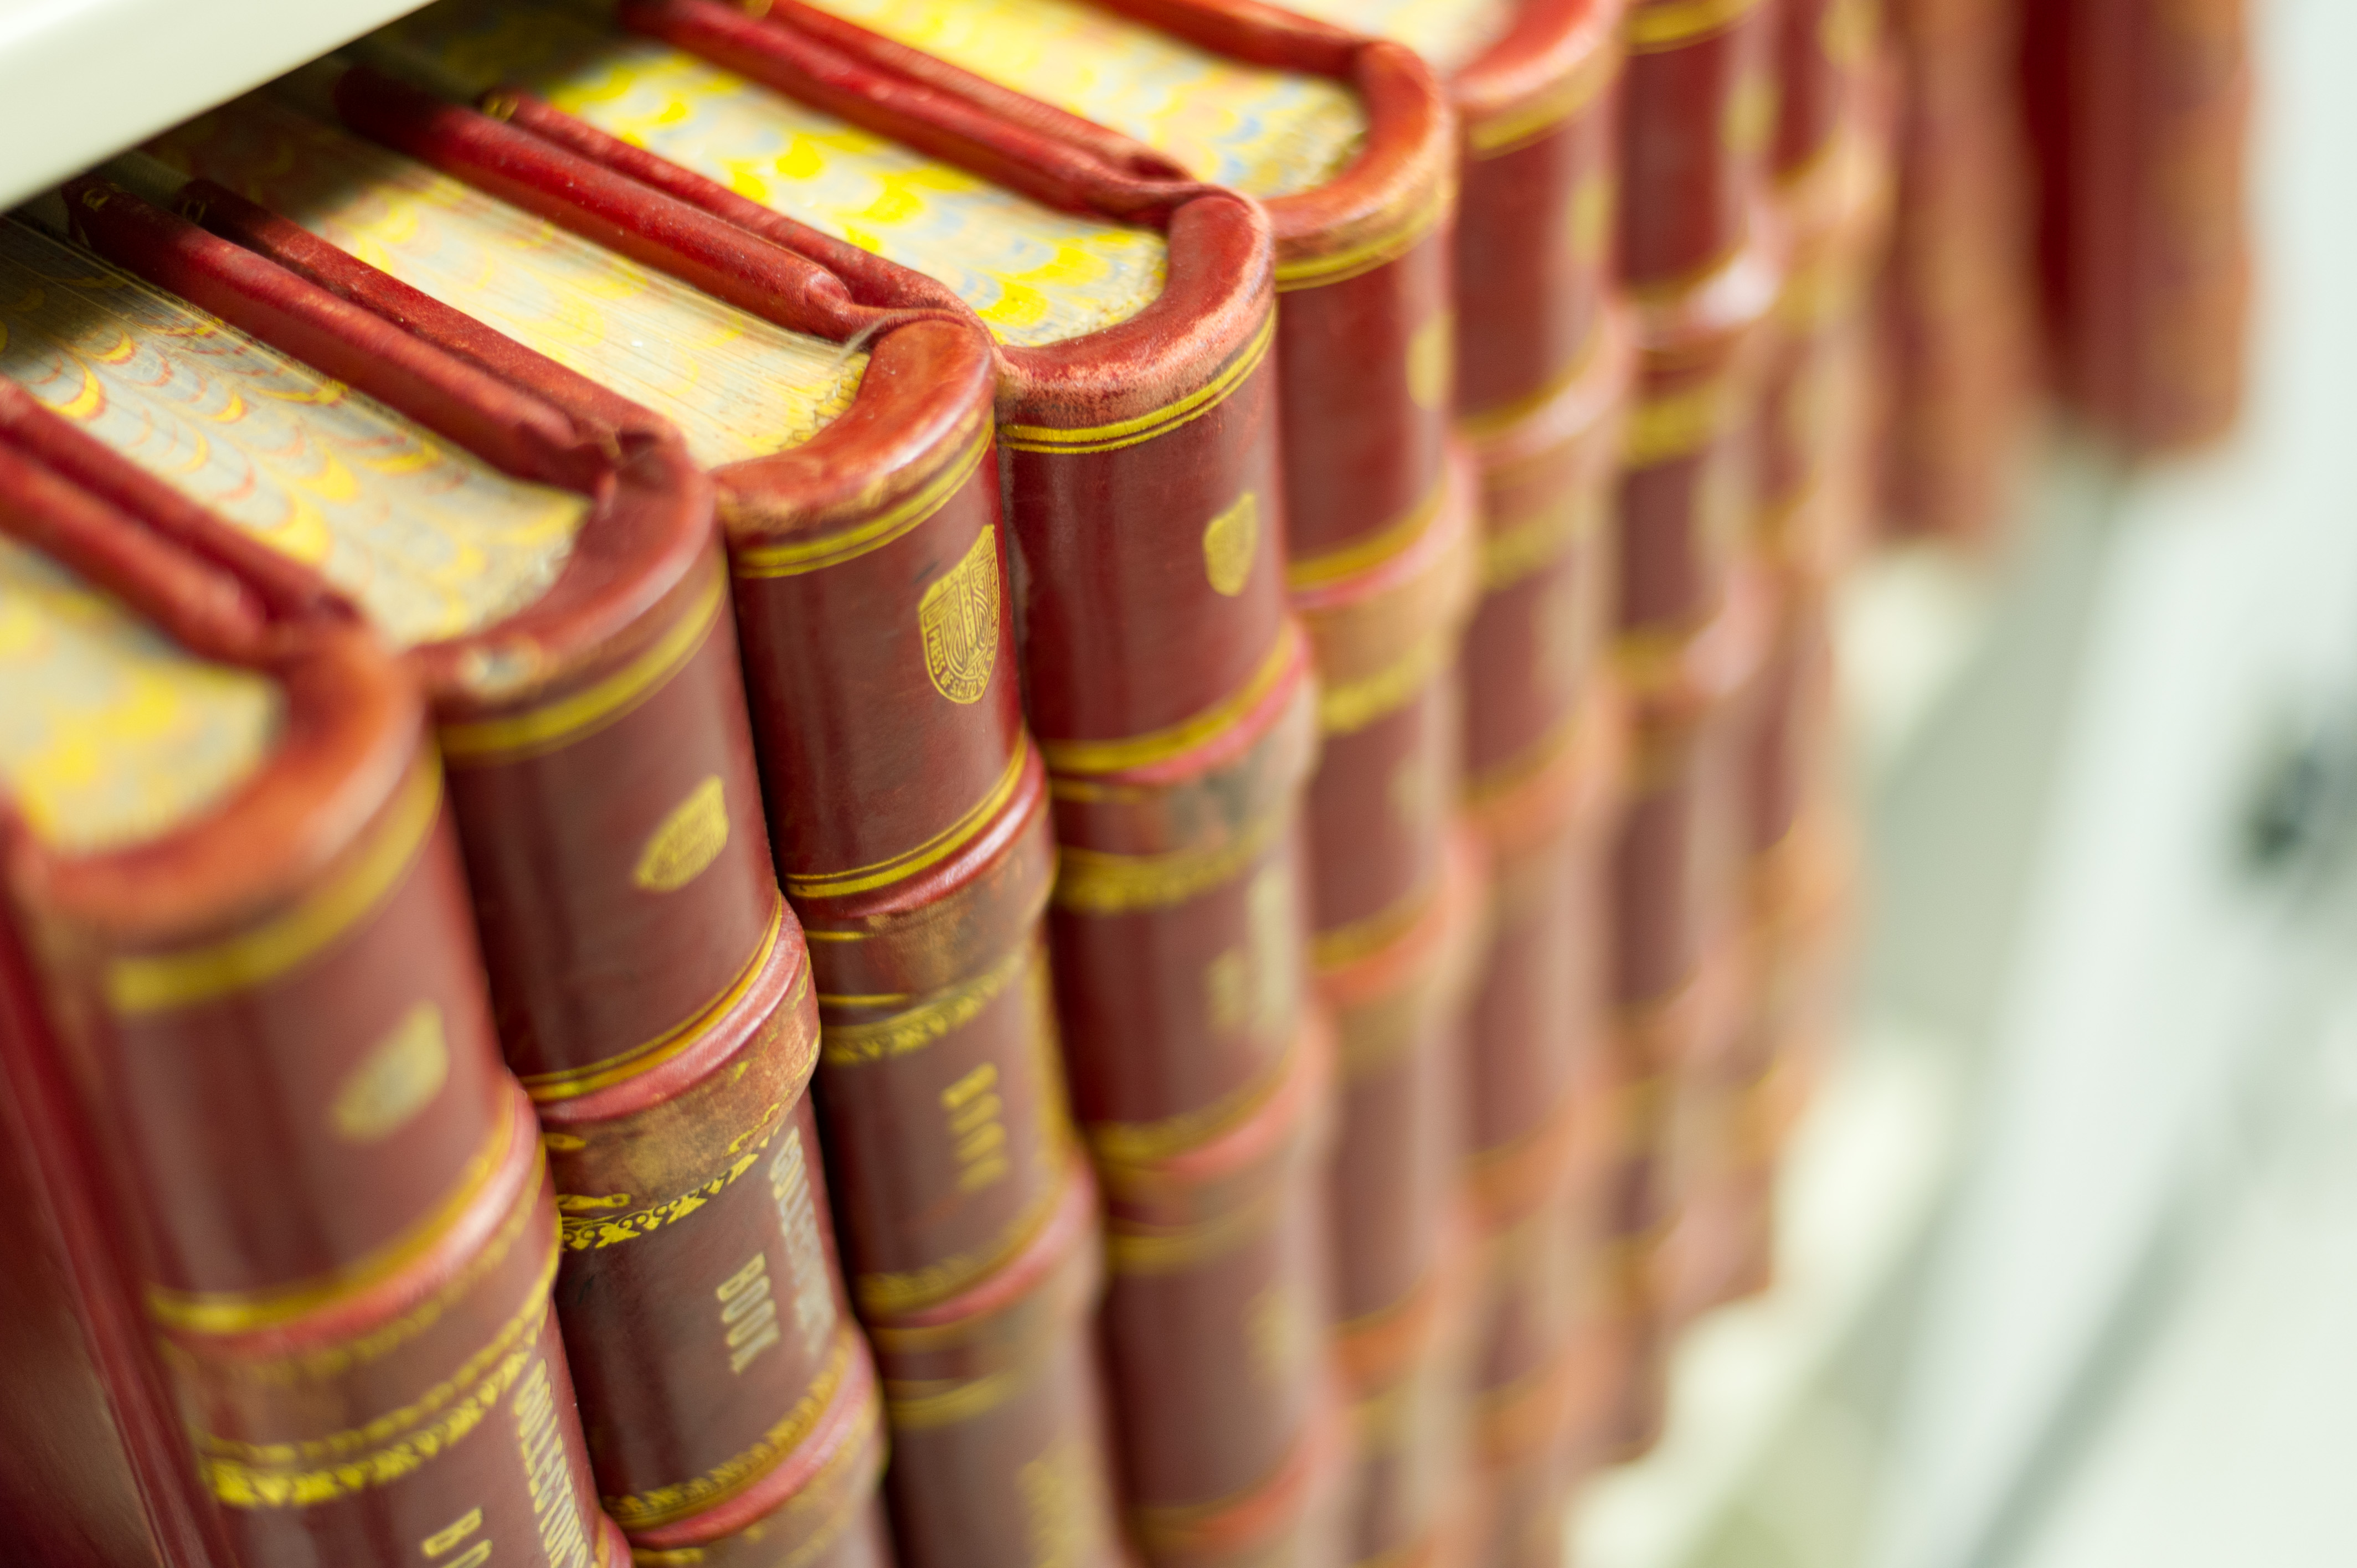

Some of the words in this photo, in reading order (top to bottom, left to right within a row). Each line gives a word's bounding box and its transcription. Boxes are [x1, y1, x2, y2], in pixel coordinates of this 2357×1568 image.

[928, 627, 945, 675] PRESS
[940, 670, 955, 688] OF
[717, 1252, 780, 1375] BOOK
